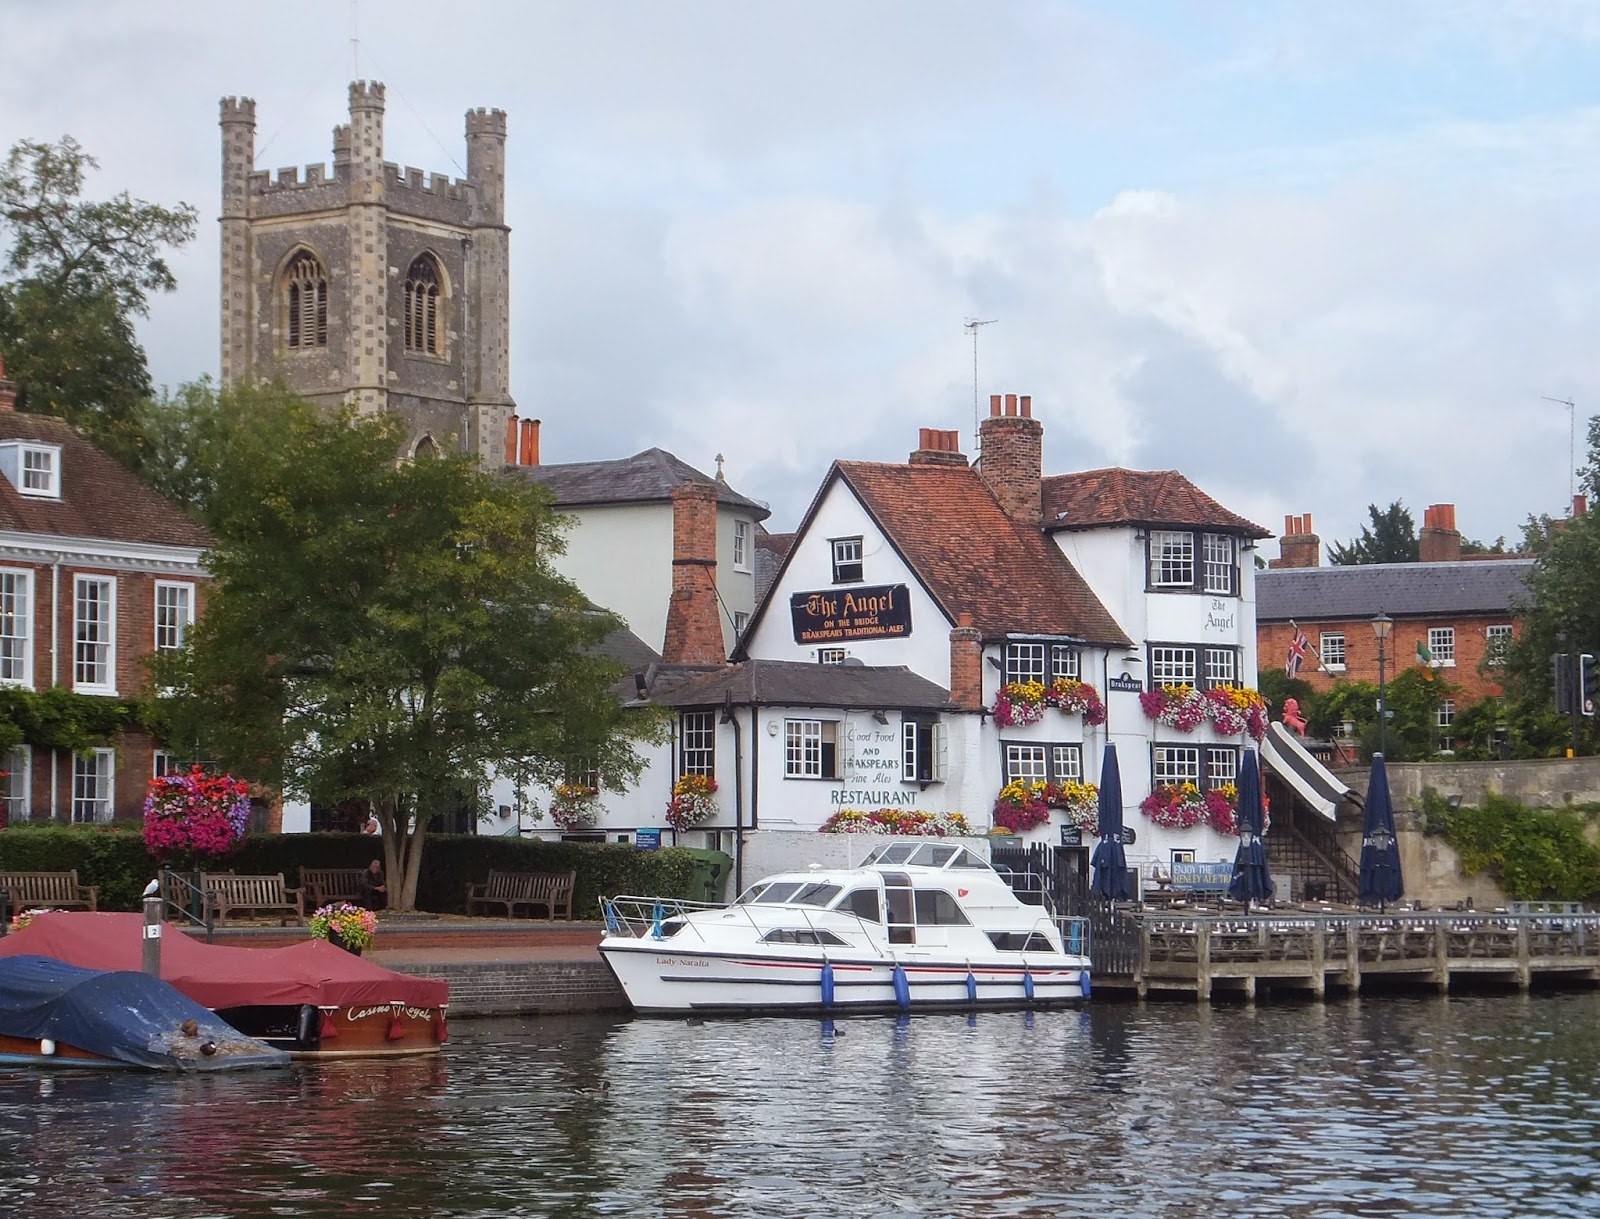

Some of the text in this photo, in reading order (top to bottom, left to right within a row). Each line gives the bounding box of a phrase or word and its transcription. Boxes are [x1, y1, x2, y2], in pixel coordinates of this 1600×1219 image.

[806, 591, 894, 618] The Angel
[1211, 598, 1226, 611] The
[824, 617, 879, 628] ON THE BRIDGE
[1204, 611, 1234, 633] Angel
[845, 626, 886, 636] TRADITIONAL
[888, 625, 904, 633] ALES
[1110, 680, 1142, 689] Brakspear
[874, 731, 896, 743] Food
[862, 747, 880, 756] AND
[851, 771, 892, 784] ine Ales
[830, 790, 918, 805] RESTAURANT
[1174, 865, 1196, 874] ENJOY
[1199, 865, 1212, 874] THE
[1174, 875, 1200, 883] HENLEY
[1203, 875, 1217, 883] ALE
[656, 958, 676, 966] Lady
[347, 1005, 391, 1022] Casino
